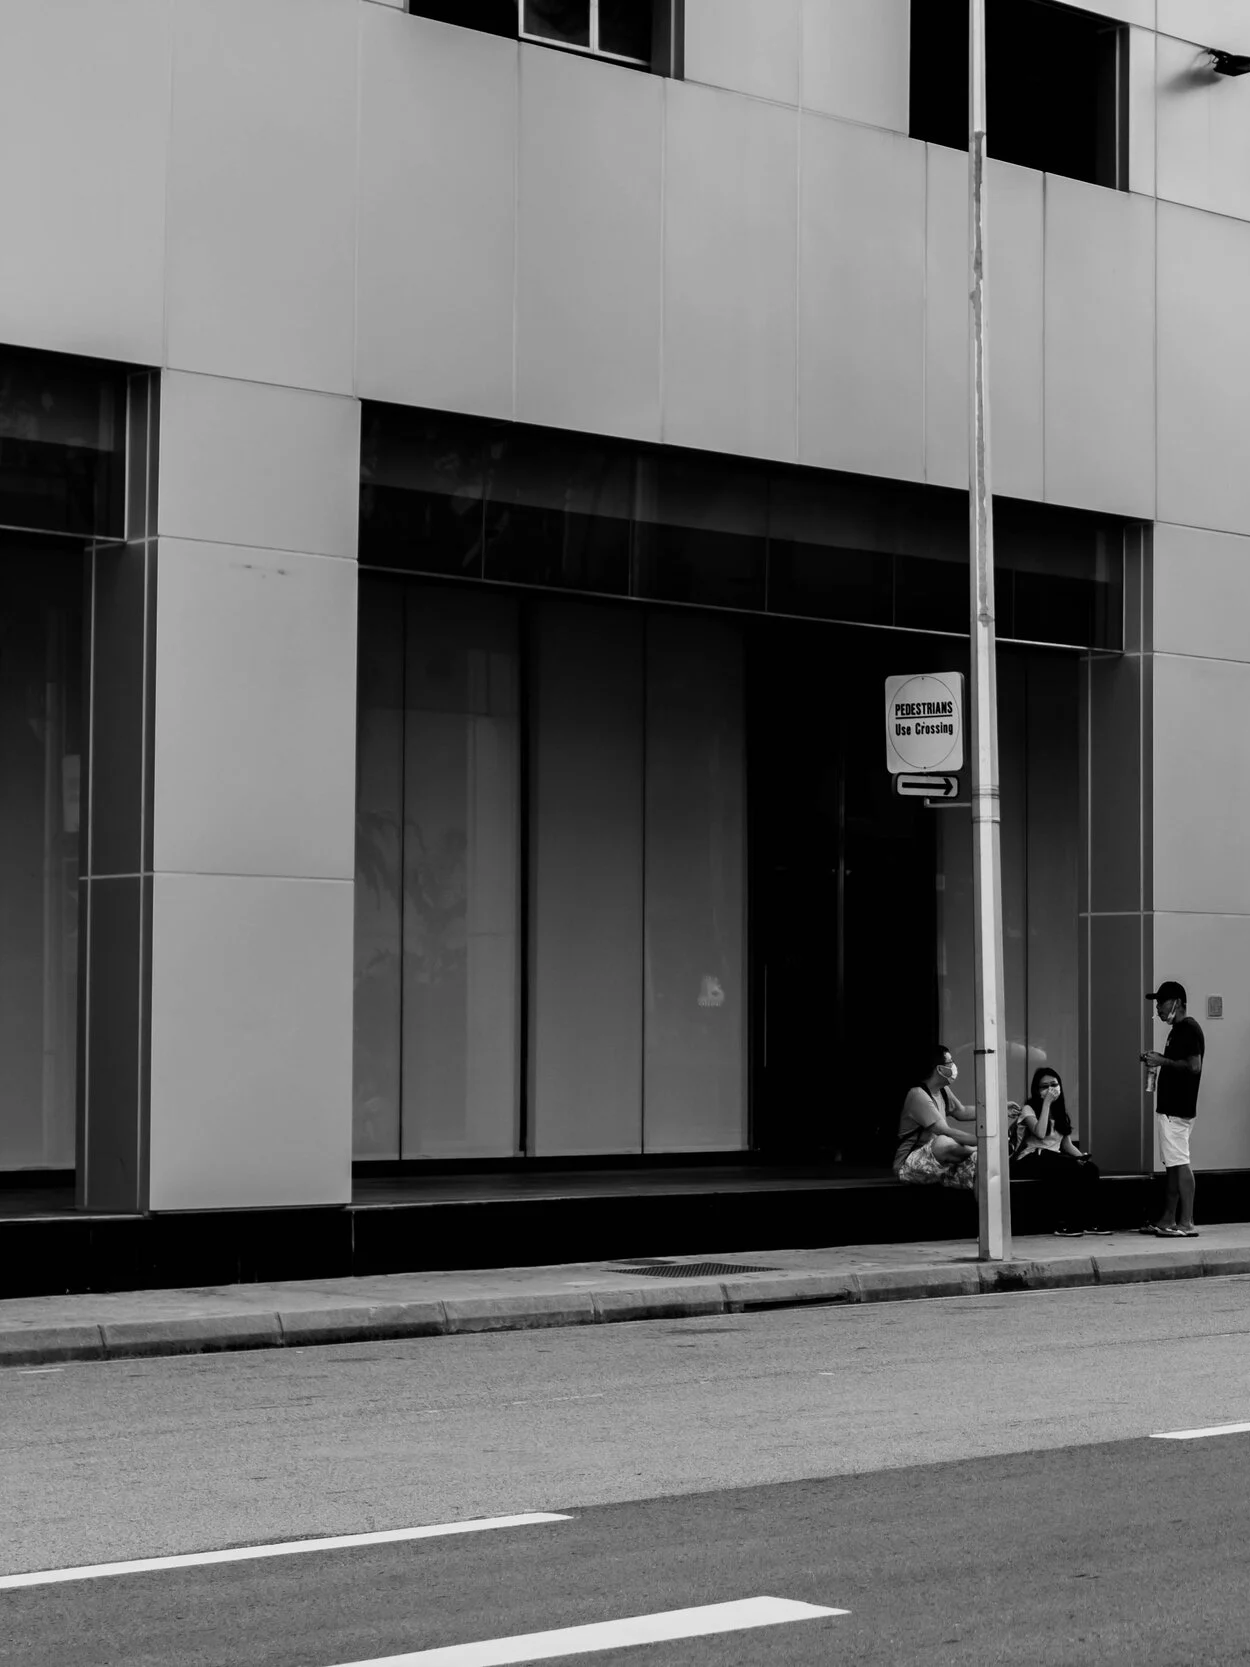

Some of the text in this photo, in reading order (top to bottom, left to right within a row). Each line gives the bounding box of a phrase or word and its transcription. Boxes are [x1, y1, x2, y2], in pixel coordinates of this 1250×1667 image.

[895, 701, 953, 716] PEDESTRIANS
[895, 721, 953, 736] Use Crossing
